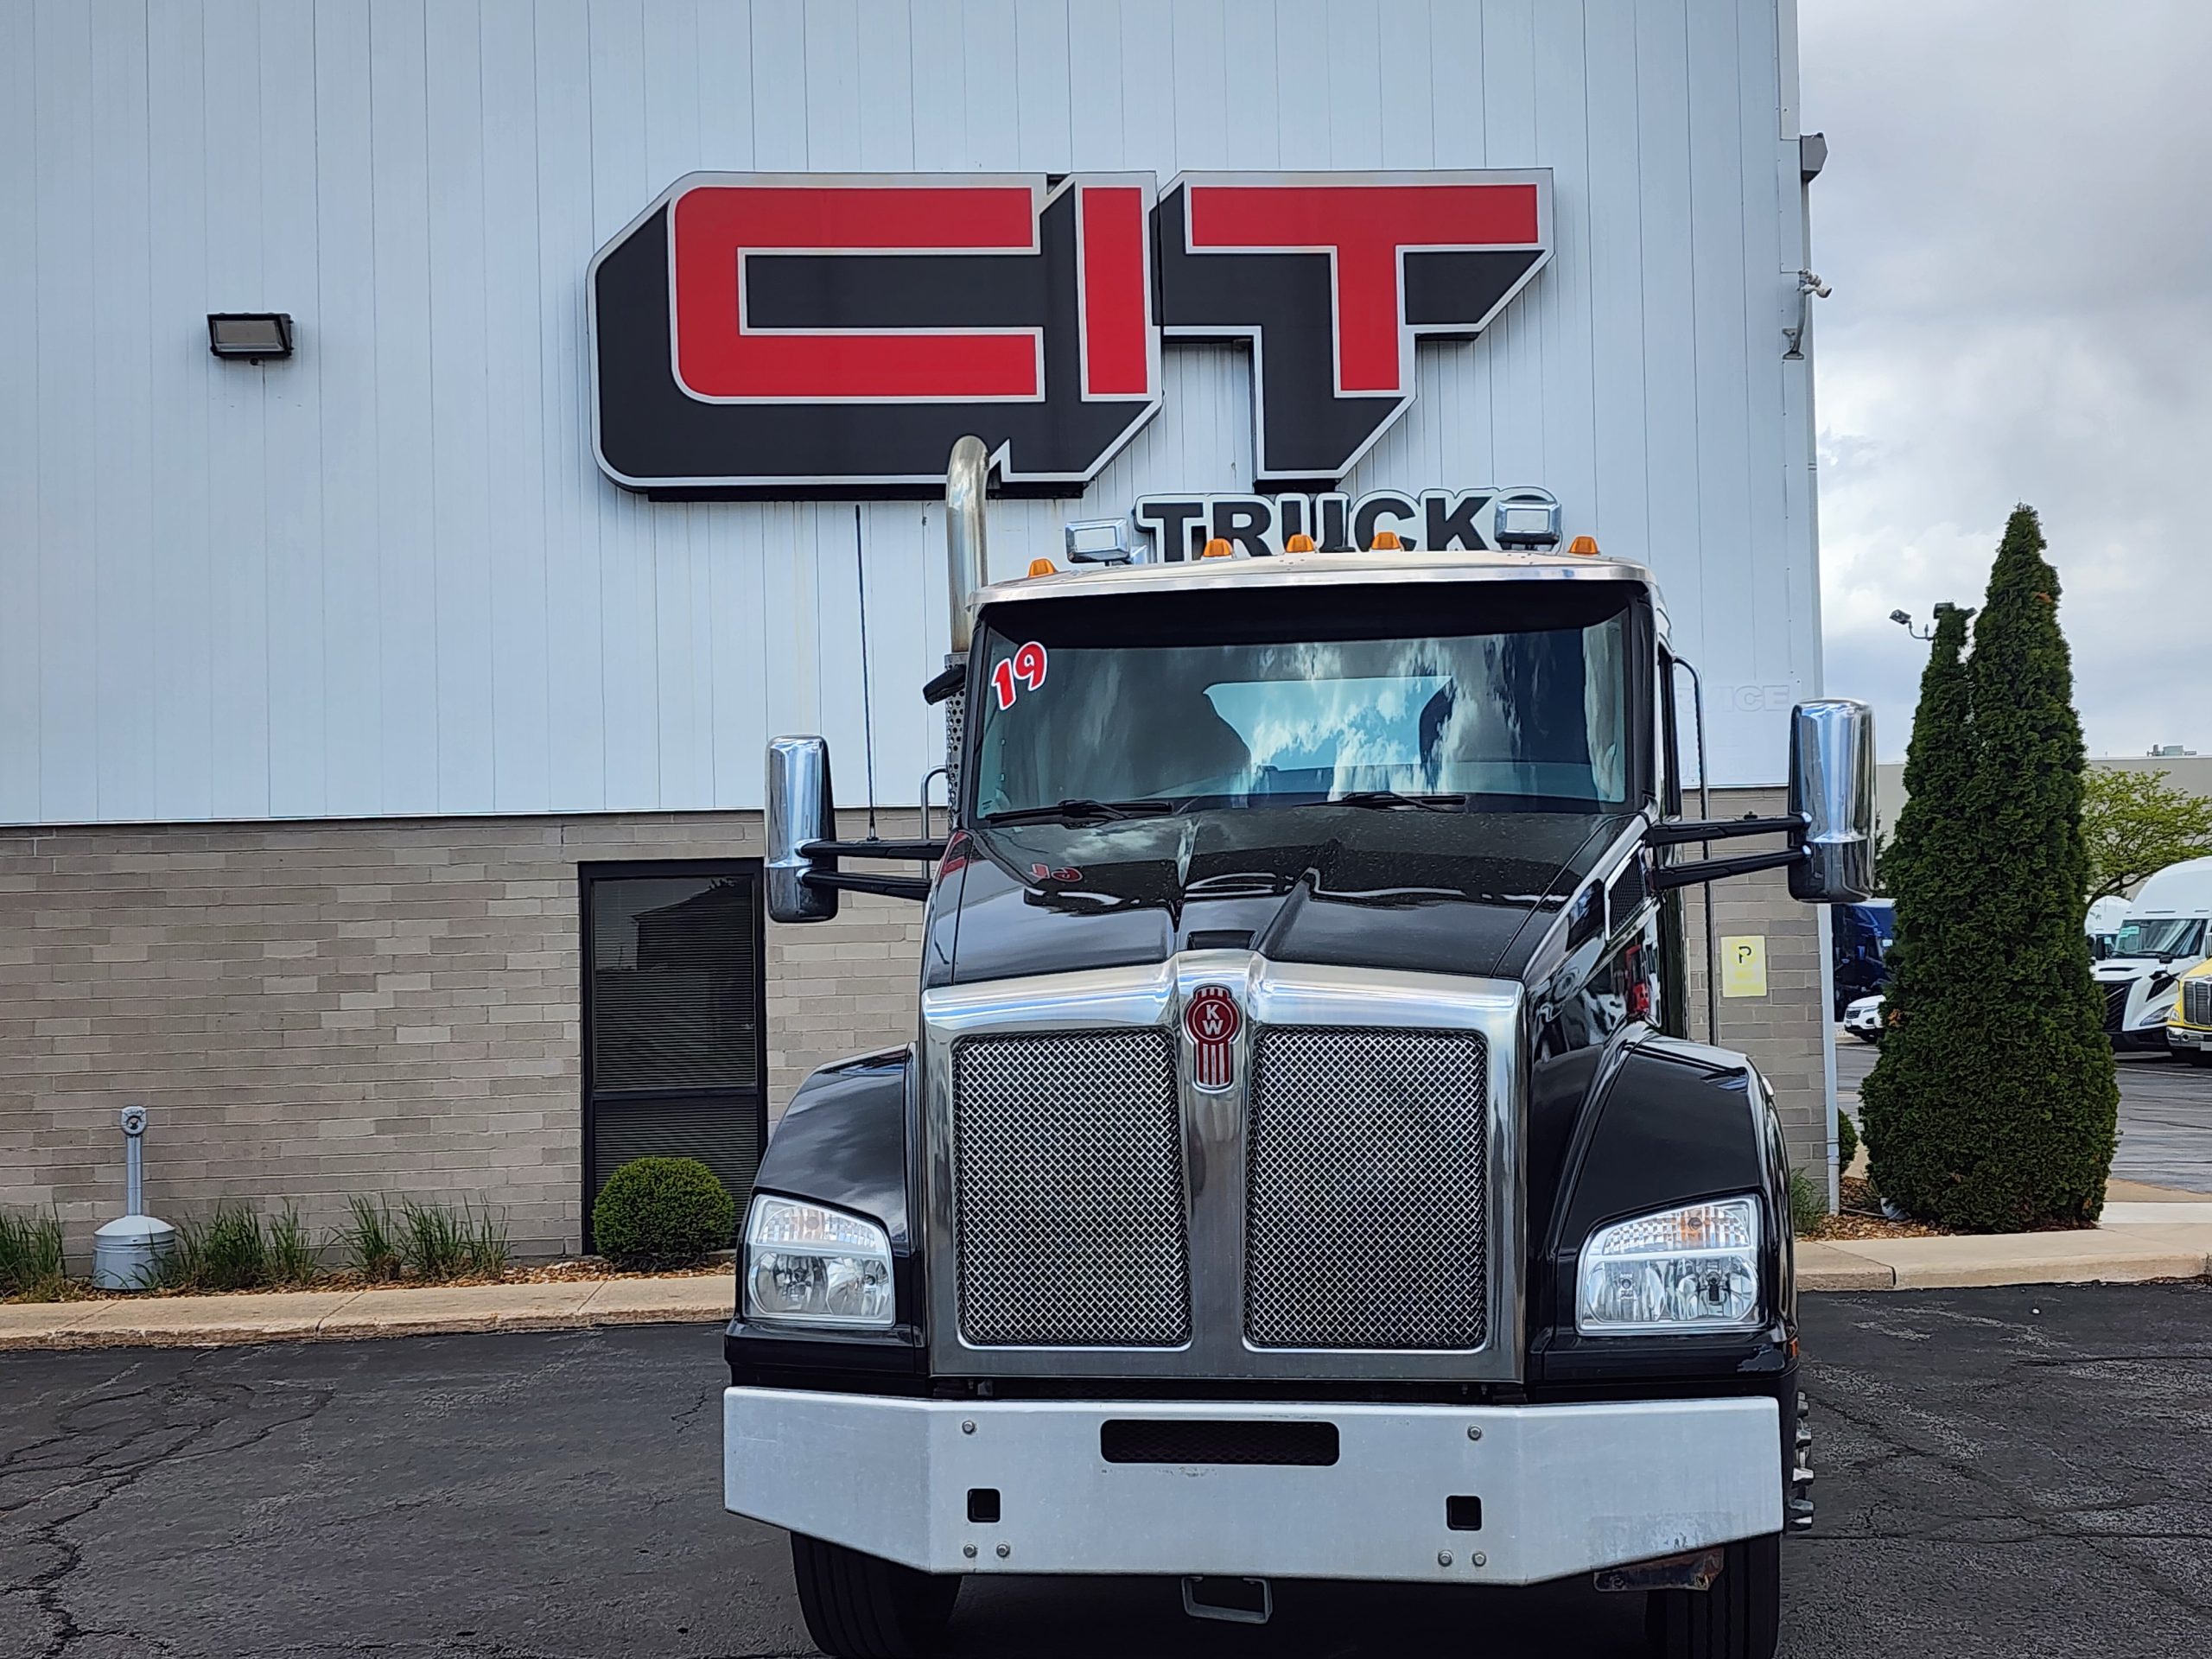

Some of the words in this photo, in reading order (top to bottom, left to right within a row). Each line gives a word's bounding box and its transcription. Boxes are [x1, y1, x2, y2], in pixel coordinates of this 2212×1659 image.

[664, 171, 1552, 410] CIT
[1138, 493, 1557, 563] TRUCK
[991, 641, 1047, 710] 19
